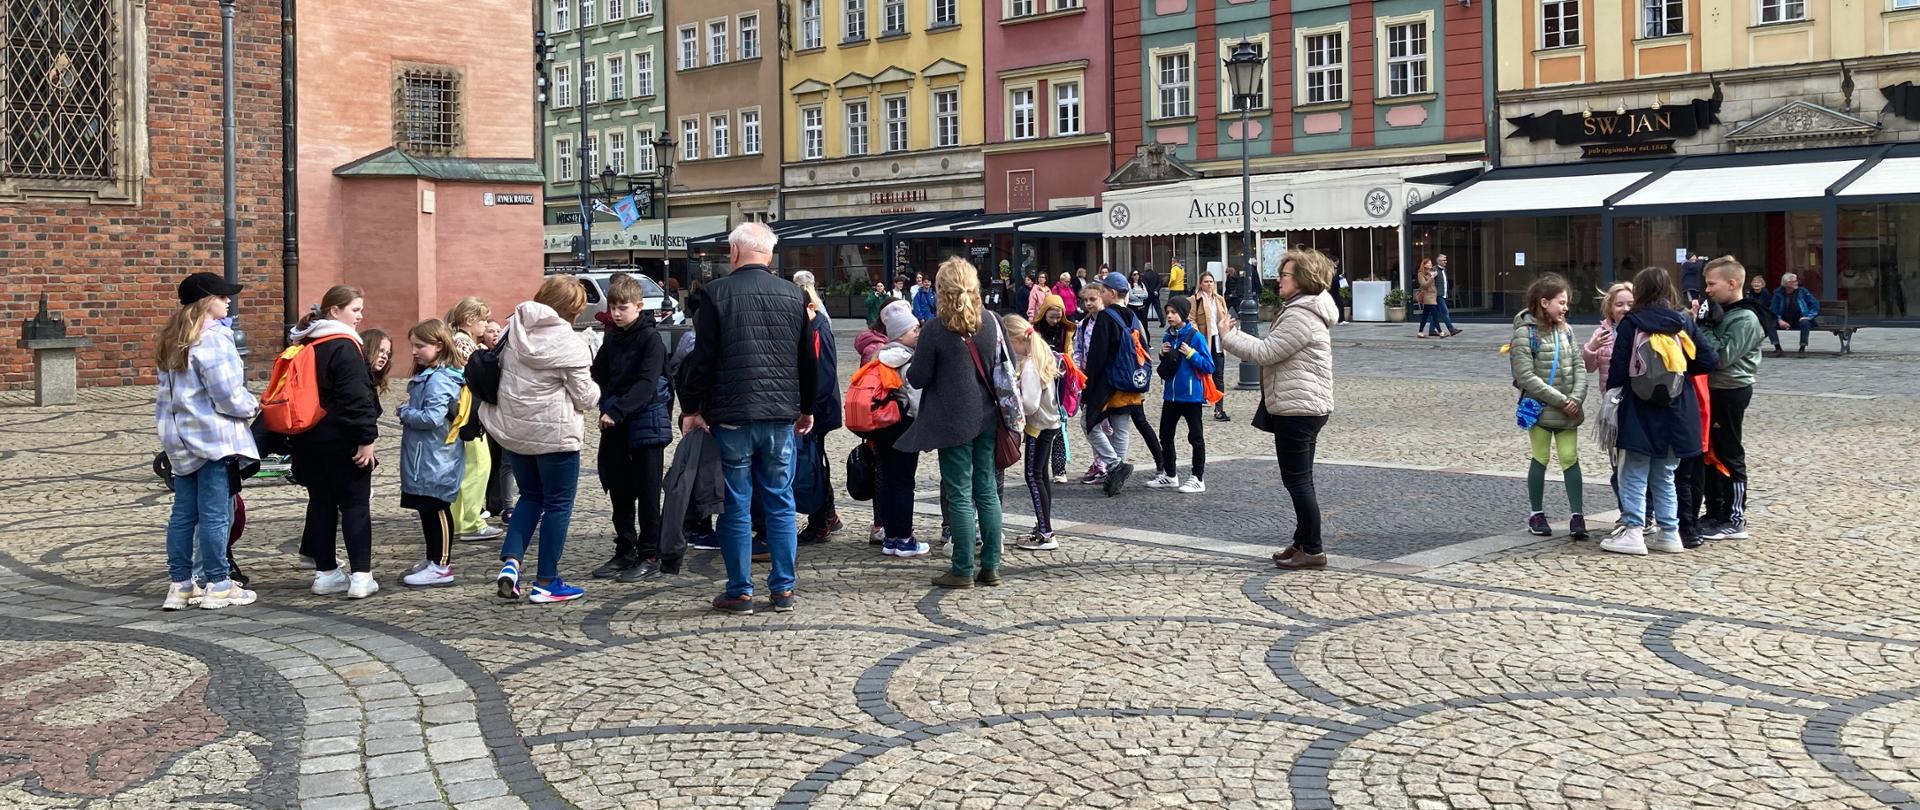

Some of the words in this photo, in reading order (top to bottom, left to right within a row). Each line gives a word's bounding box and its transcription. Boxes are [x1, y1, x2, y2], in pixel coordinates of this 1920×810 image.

[1627, 111, 1672, 137] JAN
[1015, 177, 1026, 185] SO
[1213, 216, 1268, 225] TAVENA
[650, 233, 686, 247] WHSKEY
